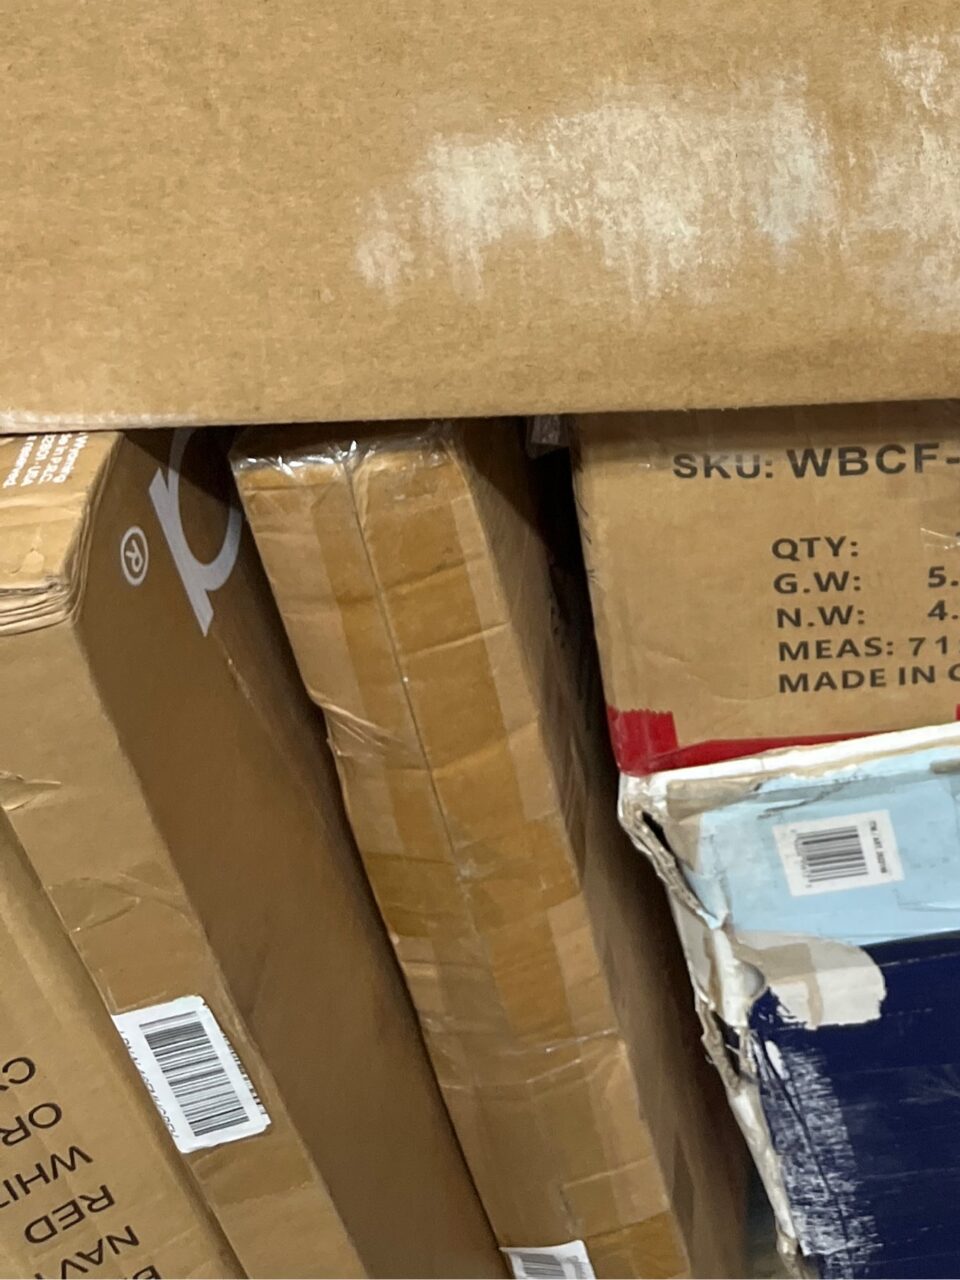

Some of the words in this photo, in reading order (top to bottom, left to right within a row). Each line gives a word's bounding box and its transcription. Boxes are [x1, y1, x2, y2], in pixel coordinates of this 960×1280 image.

[672, 451, 774, 481] SKU:
[771, 536, 859, 561] QTY:
[773, 571, 862, 595] G.W:
[776, 605, 865, 629] N.W:
[778, 637, 895, 661] MEAS:
[778, 667, 886, 693] MADE
[897, 664, 936, 685] IN
[24, 1184, 116, 1244] RED
[34, 1224, 140, 1280] NAV
